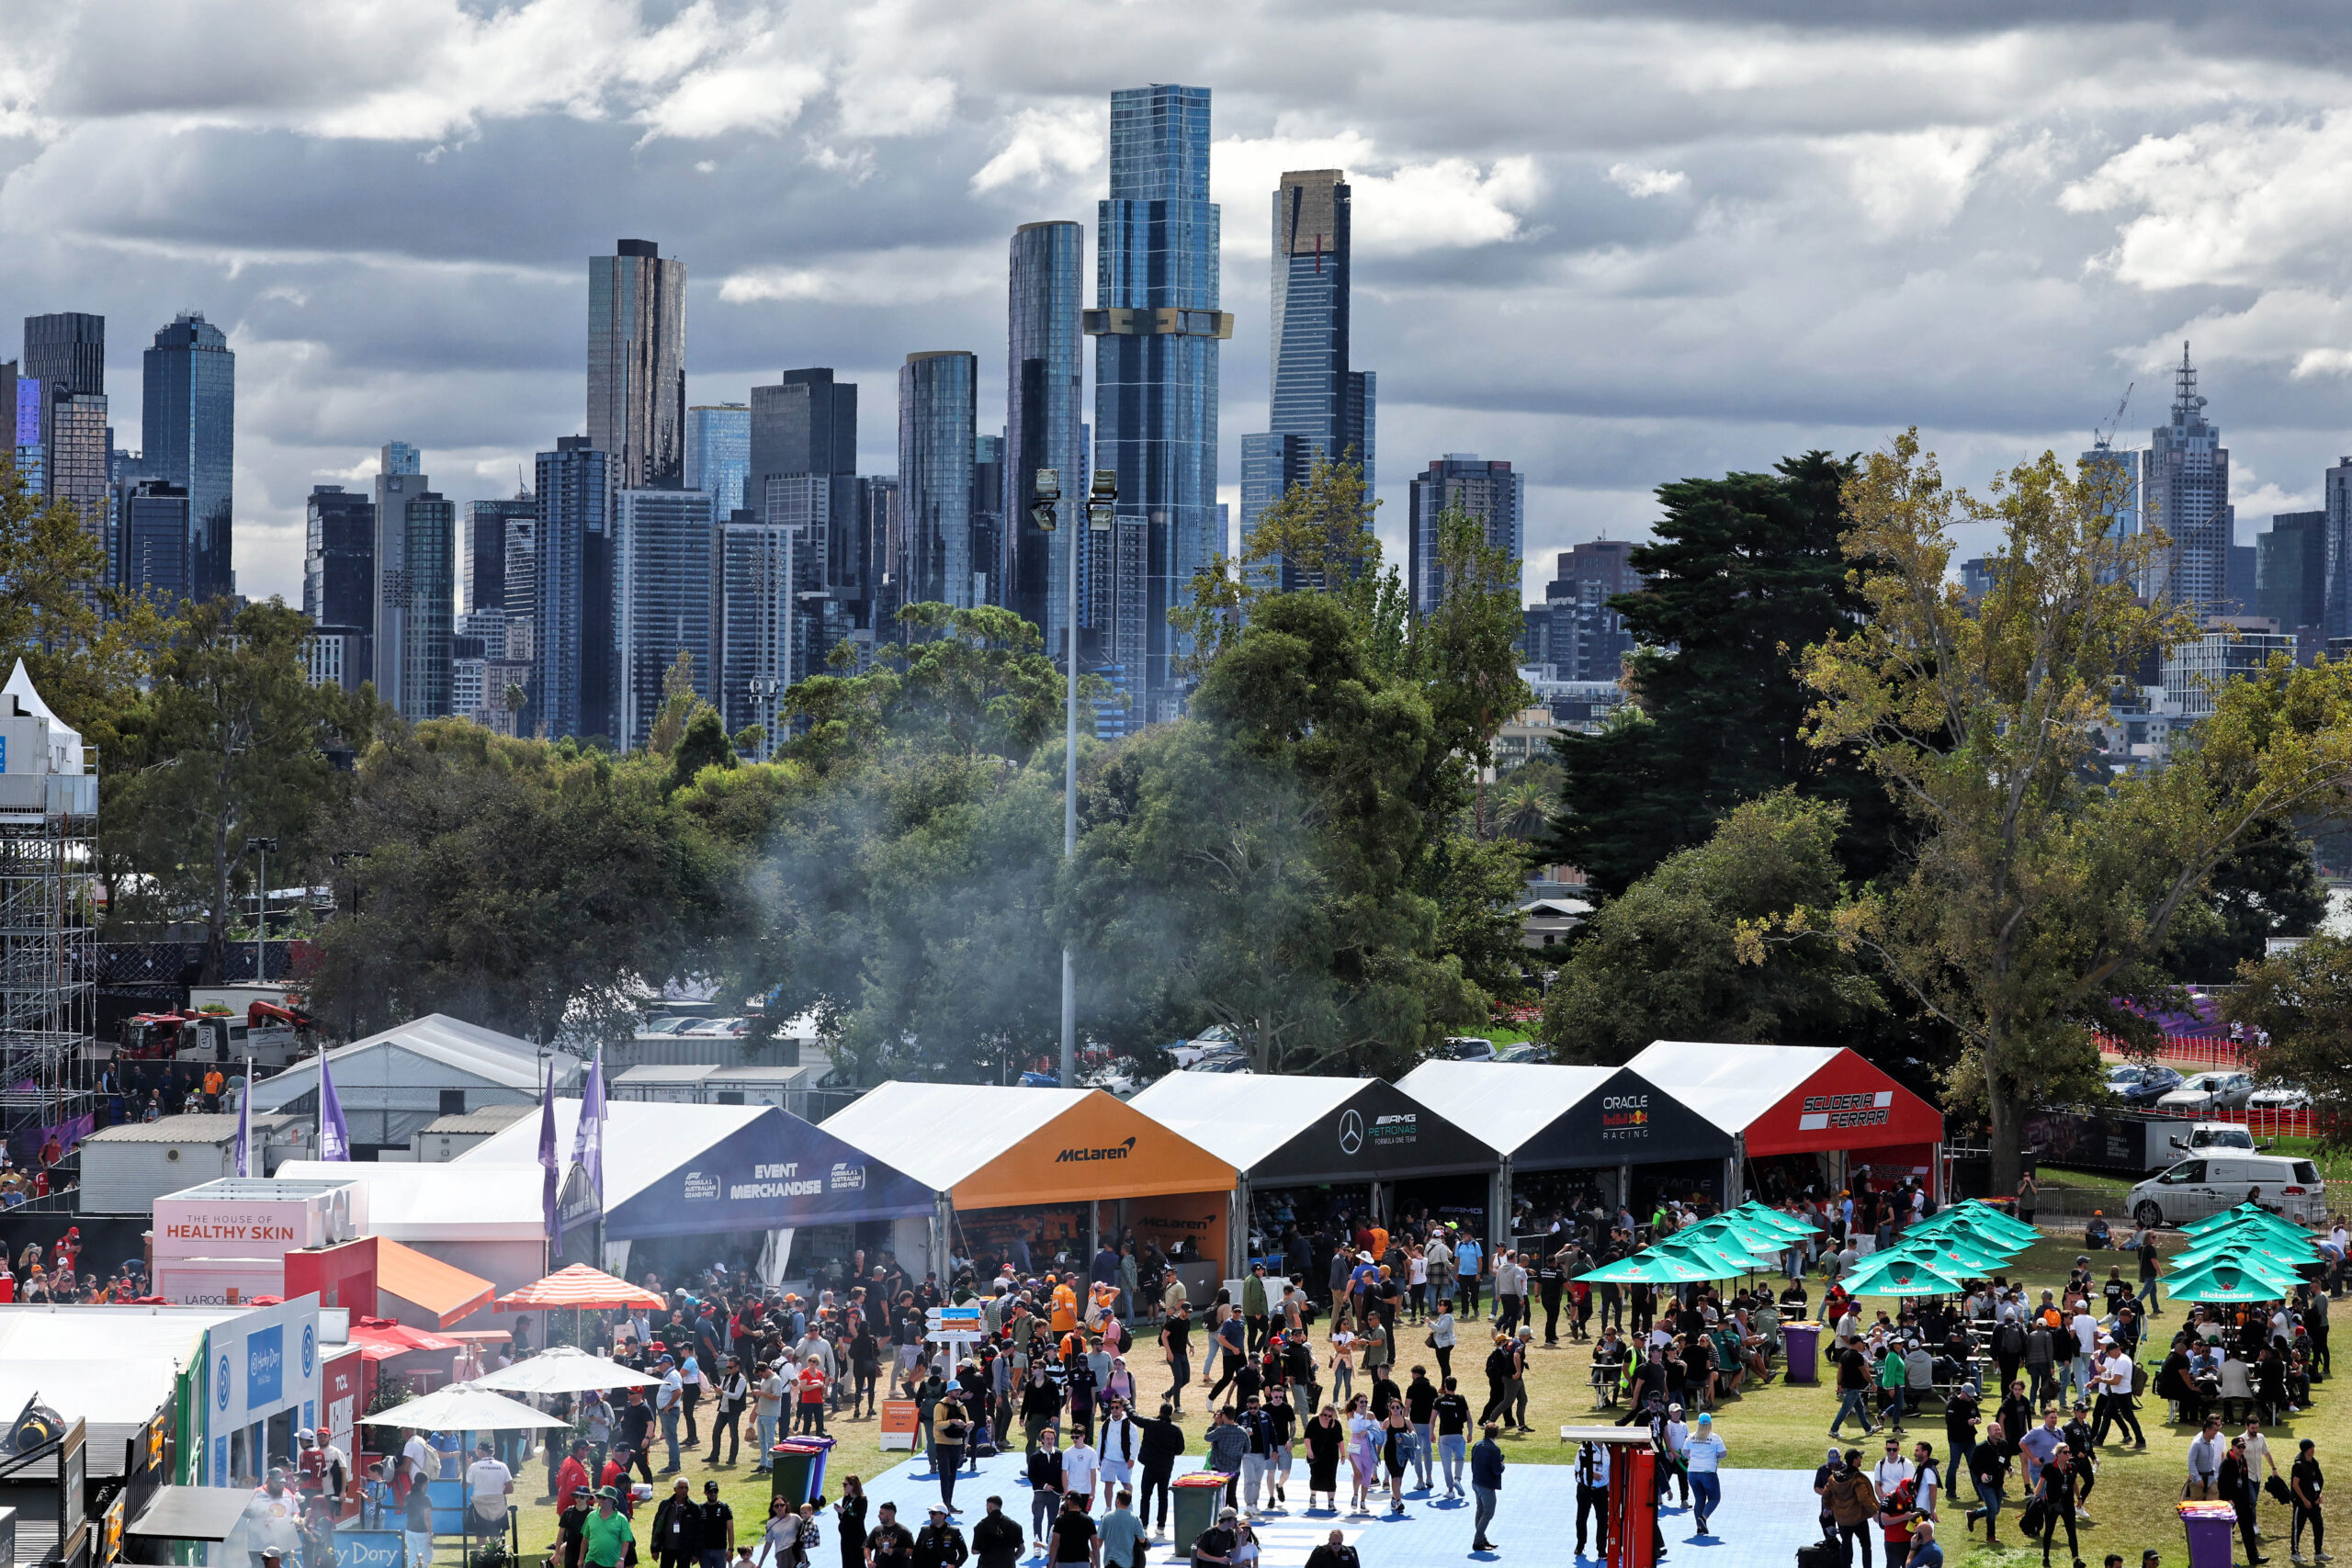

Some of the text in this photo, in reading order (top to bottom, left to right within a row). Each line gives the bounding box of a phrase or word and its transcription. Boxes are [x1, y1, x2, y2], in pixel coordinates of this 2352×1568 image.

[1603, 1095, 1647, 1110] ORACLE
[1803, 1093, 1874, 1112] SCUDERIA
[1389, 1113, 1416, 1123] AMG
[1603, 1112, 1628, 1124] Red Bull
[1828, 1108, 1889, 1128] FERRARI
[1368, 1124, 1416, 1136] PETRONAS
[1603, 1130, 1647, 1139] RACING
[1055, 1148, 1127, 1162] McLaren
[755, 1163, 797, 1179] EVENT
[730, 1179, 821, 1200] MERCHANDISE
[187, 1214, 208, 1224] THE
[213, 1215, 252, 1224] HOUSE
[307, 1190, 356, 1247] TCL
[167, 1225, 294, 1240] HEALTHY SKIN
[1880, 1285, 1932, 1293] Heineken
[186, 1295, 199, 1304] LA
[200, 1295, 239, 1305] ROCHE
[335, 1374, 348, 1393] TCL
[316, 1462, 322, 1477] 7
[353, 1541, 399, 1567] Dory
